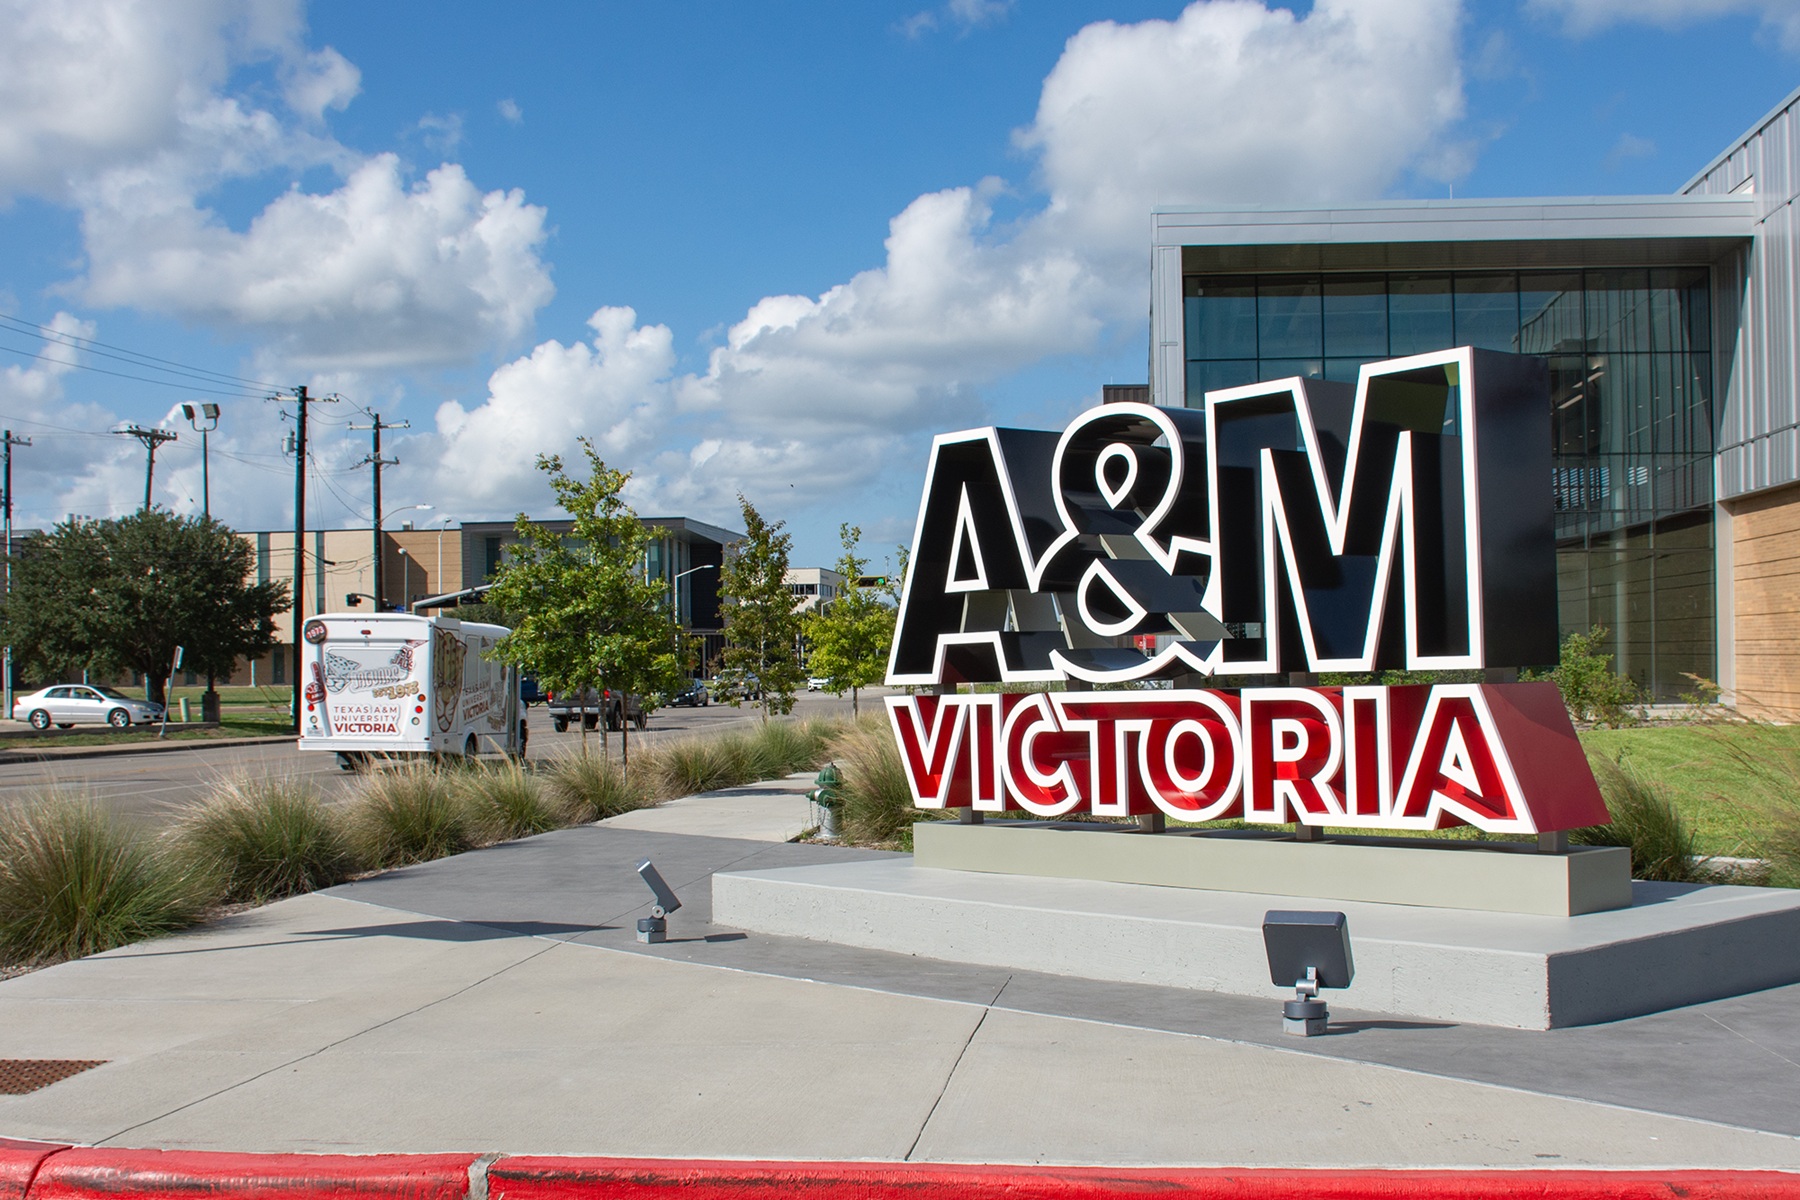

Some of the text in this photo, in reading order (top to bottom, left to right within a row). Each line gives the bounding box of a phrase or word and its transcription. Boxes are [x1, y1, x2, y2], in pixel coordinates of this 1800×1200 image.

[884, 346, 1485, 685] A&M
[306, 625, 325, 639] 1973
[388, 681, 419, 699] 1973
[334, 706, 397, 714] TEXAS A&M
[463, 700, 489, 720] VICTORIA
[334, 723, 396, 732] VICTORIA
[884, 683, 1538, 834] VICTORIA
